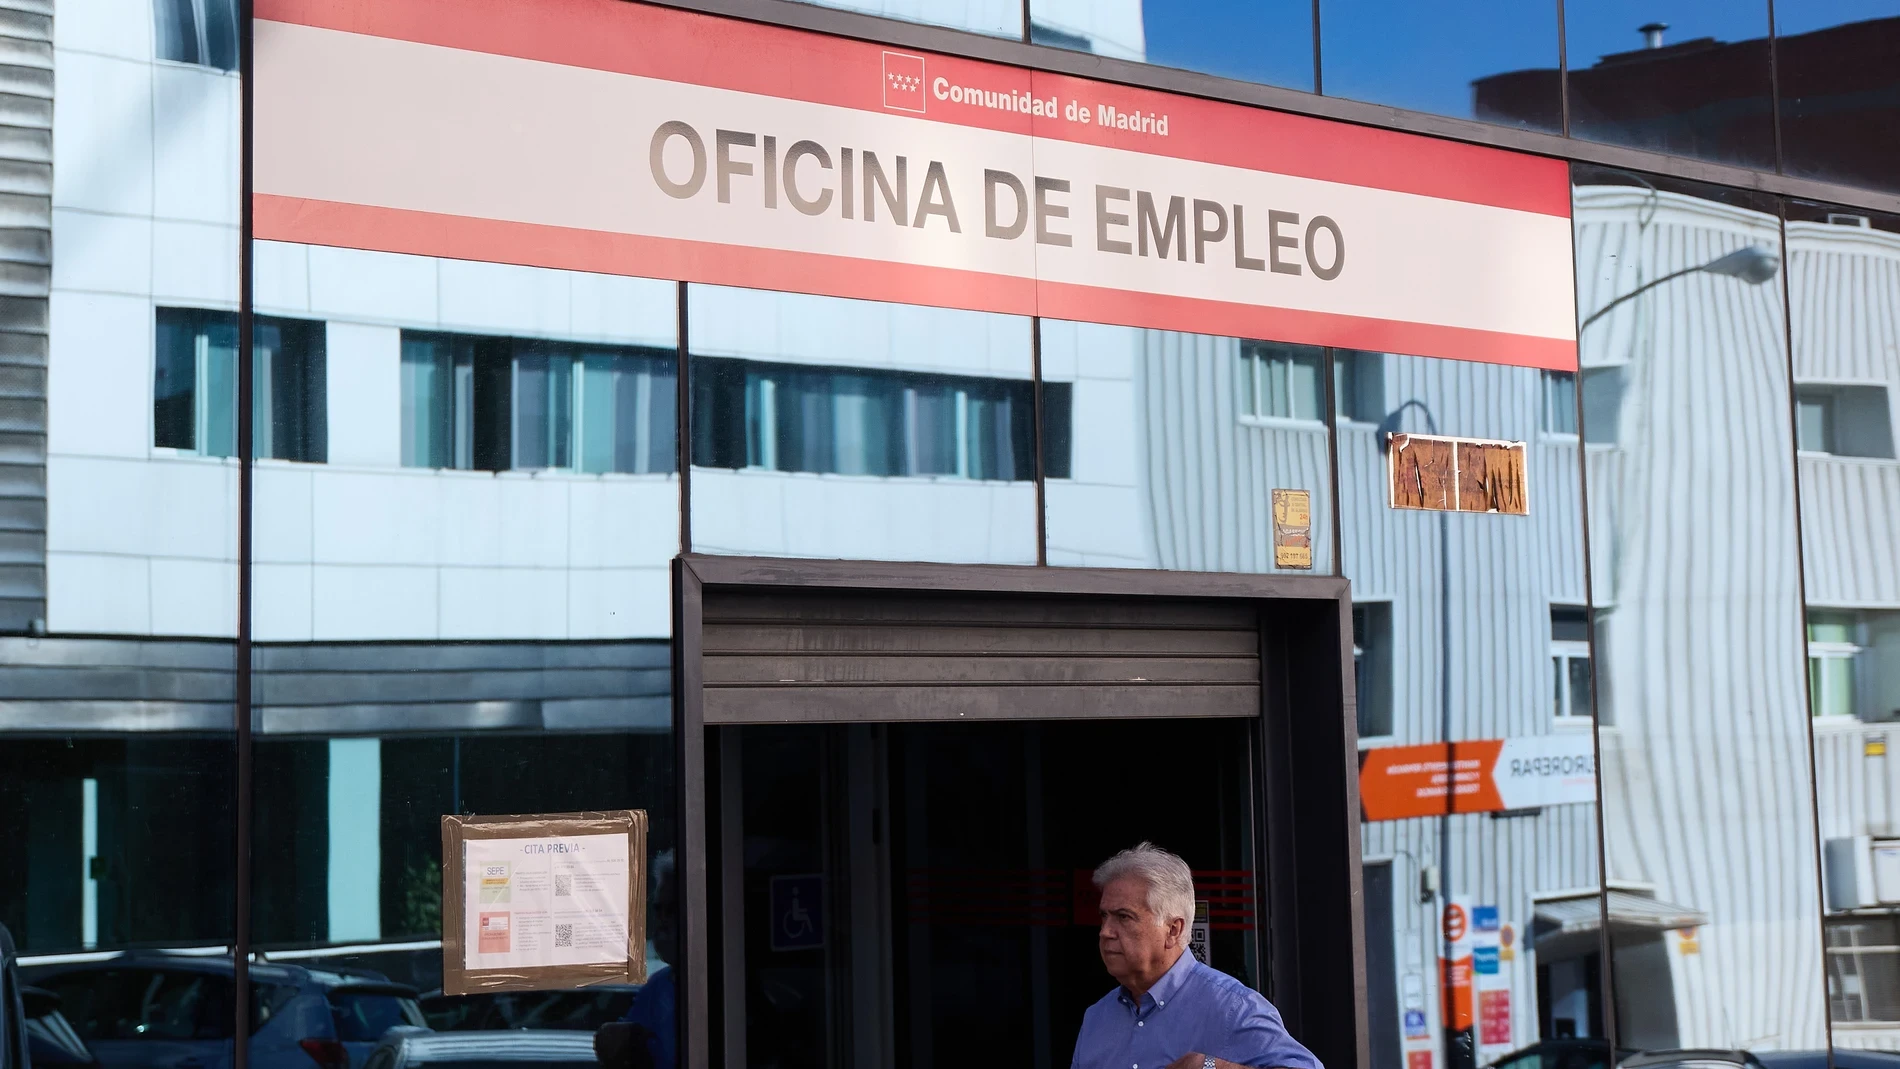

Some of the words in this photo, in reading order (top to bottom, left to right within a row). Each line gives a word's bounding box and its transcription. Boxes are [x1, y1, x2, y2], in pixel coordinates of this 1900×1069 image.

[933, 77, 1058, 118] Comunidad
[1065, 100, 1091, 123] de
[1098, 104, 1169, 136] Madrid
[649, 120, 962, 233] OFICINA
[984, 168, 1073, 247] DE
[1095, 184, 1345, 281] EMPLEO
[524, 844, 545, 854] CITA
[547, 843, 580, 853] PREVIA
[486, 866, 505, 875] SEPE
